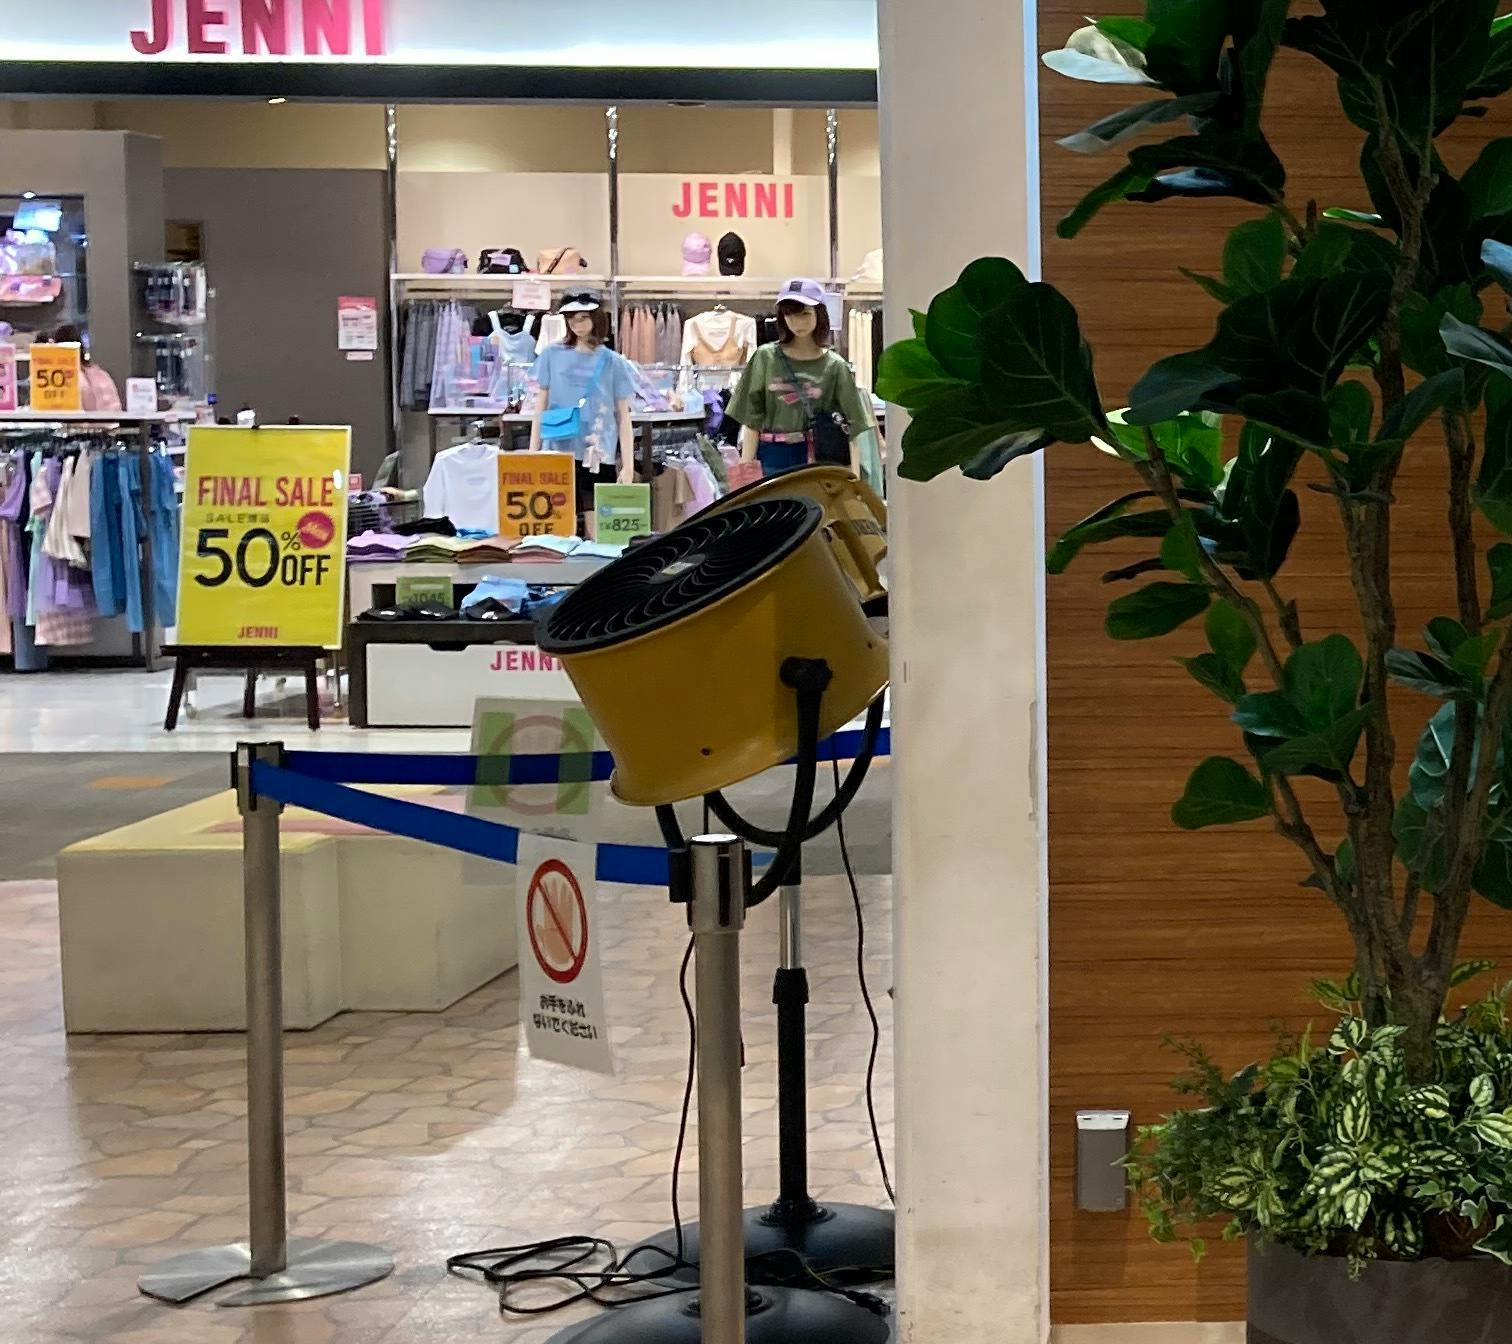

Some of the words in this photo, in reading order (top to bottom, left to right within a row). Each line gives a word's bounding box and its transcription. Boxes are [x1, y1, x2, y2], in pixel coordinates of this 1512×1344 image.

[672, 182, 793, 218] JENNI
[197, 476, 267, 506] FINAL
[275, 476, 334, 507] SALE
[502, 472, 535, 485] FINAL
[539, 472, 570, 485] SALE
[281, 554, 332, 587] OFF
[237, 626, 279, 640] JENNI
[533, 1013, 598, 1040] ないでください
